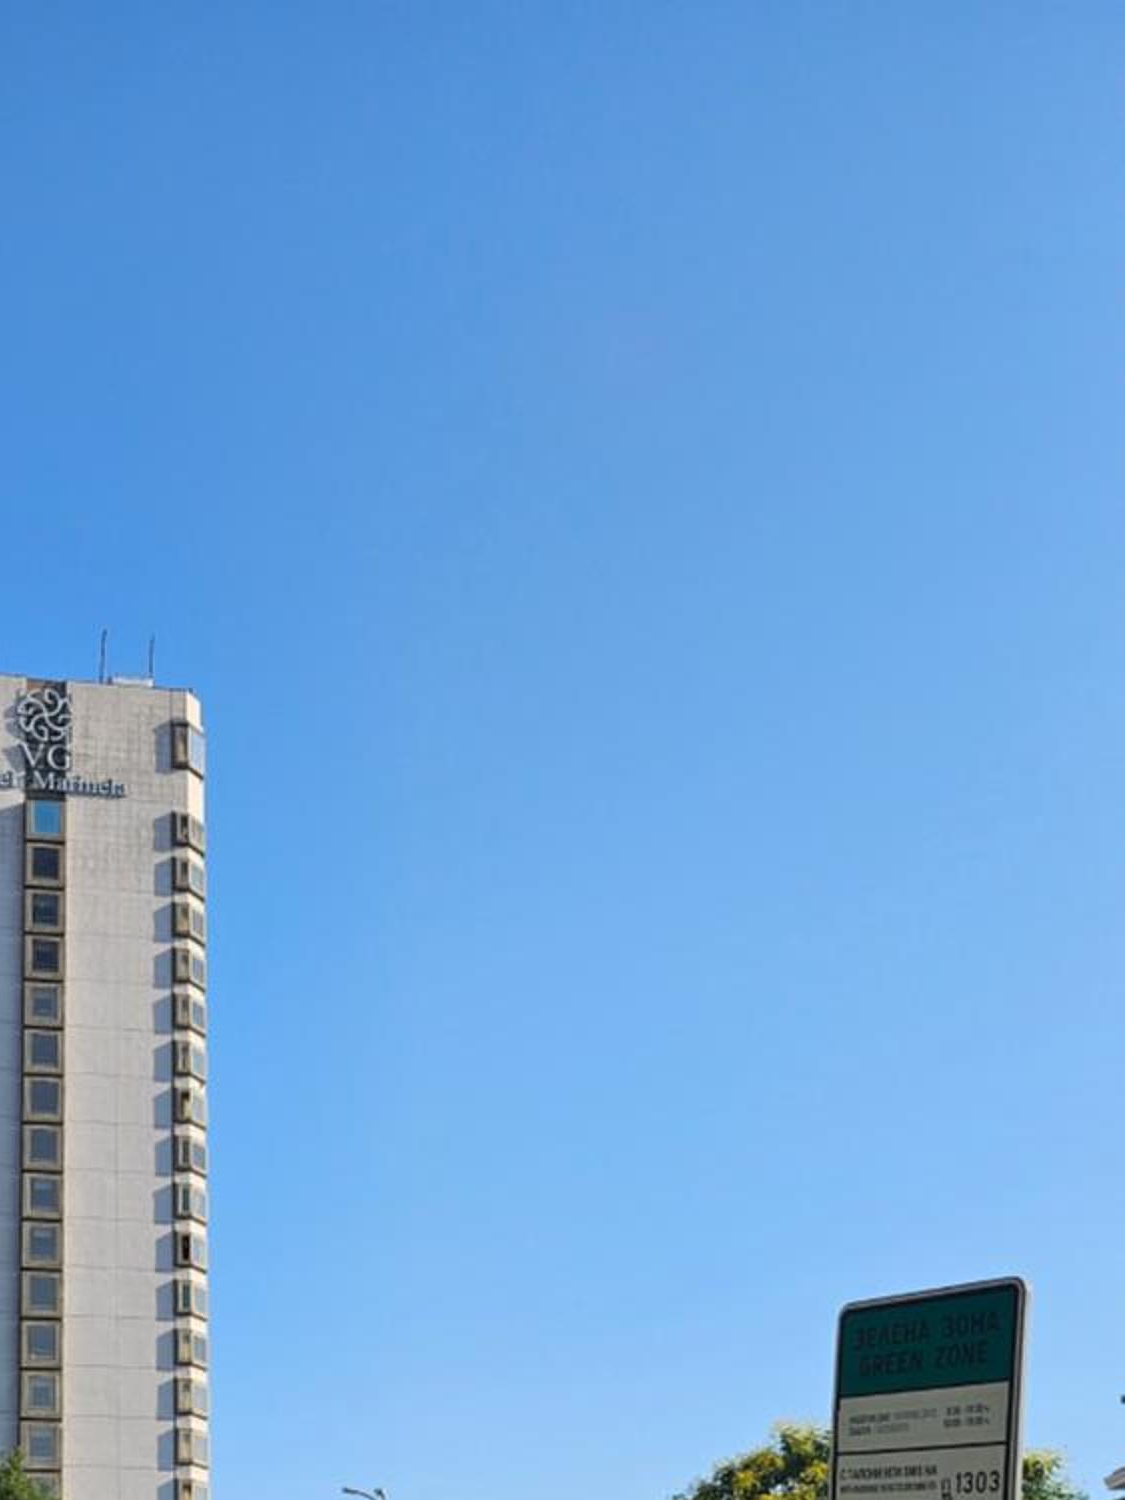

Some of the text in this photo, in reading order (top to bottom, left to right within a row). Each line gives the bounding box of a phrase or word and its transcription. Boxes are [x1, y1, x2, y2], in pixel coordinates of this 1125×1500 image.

[23, 743, 71, 770] VG
[943, 1312, 1002, 1337] ЗОНА
[860, 1341, 987, 1376] GREEN ZONE
[955, 1470, 1001, 1494] 1303
